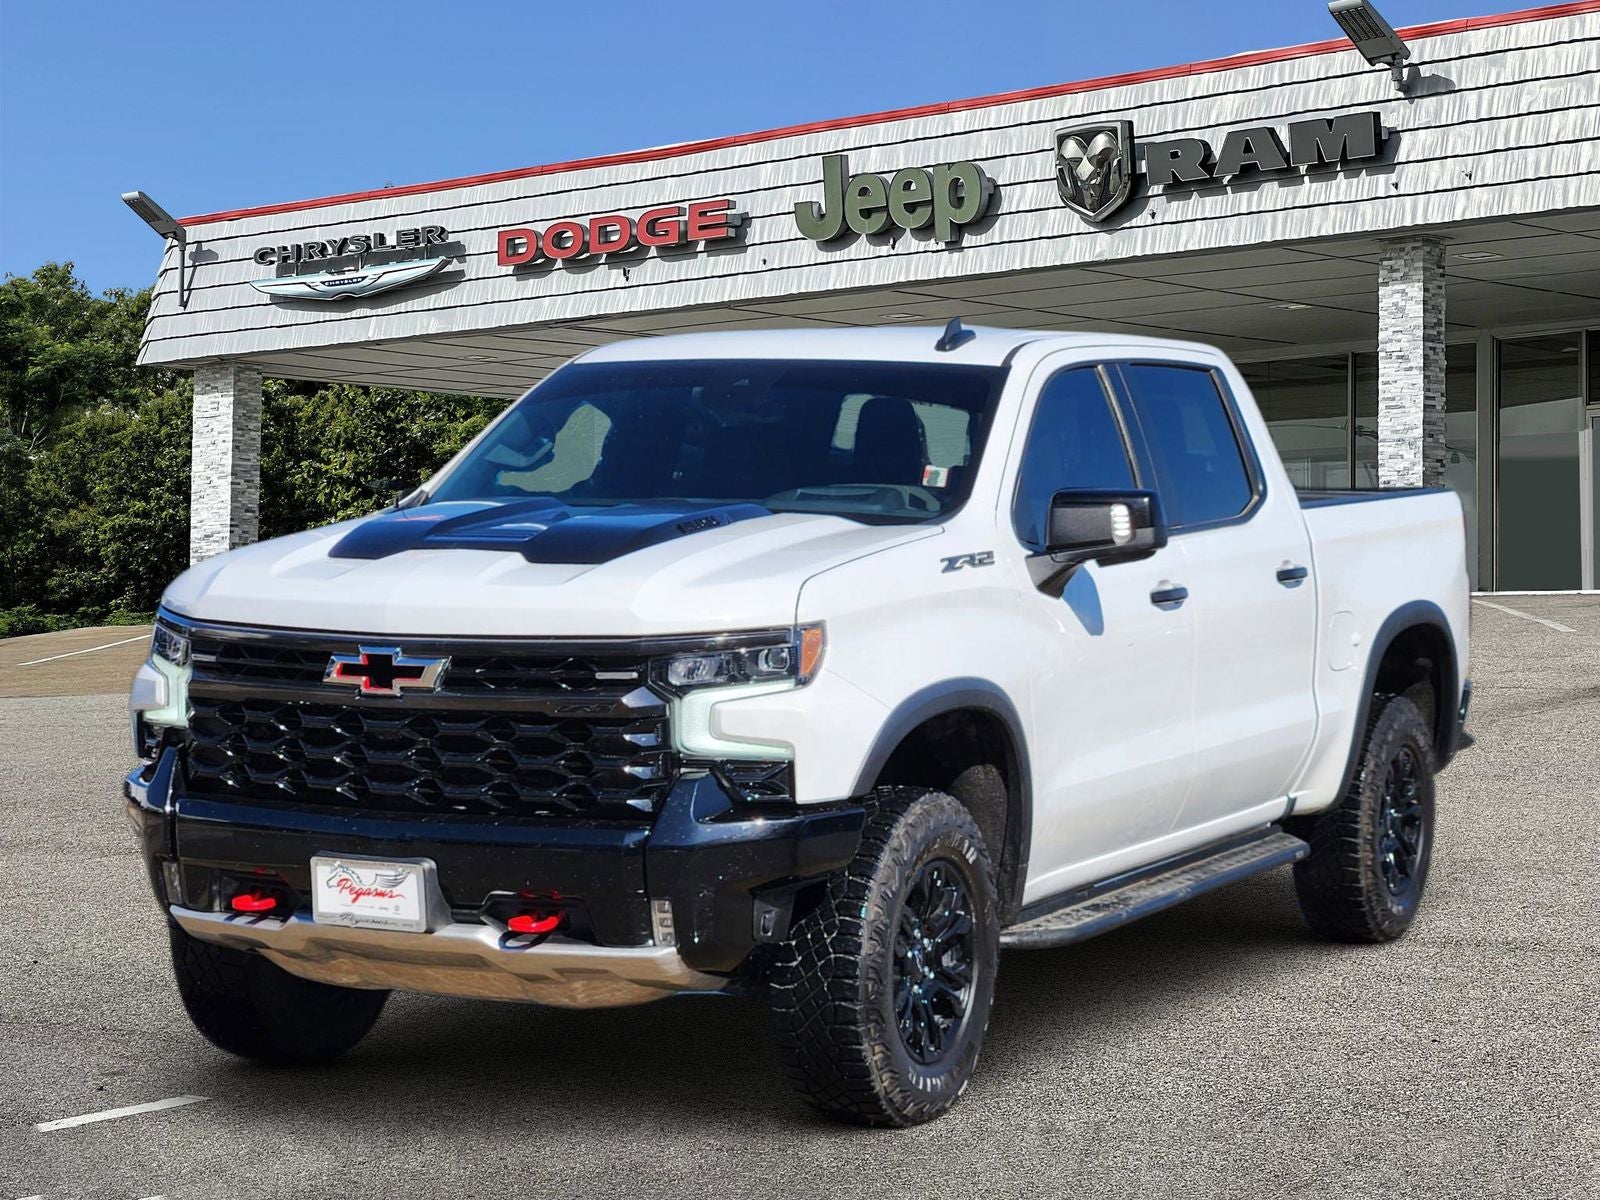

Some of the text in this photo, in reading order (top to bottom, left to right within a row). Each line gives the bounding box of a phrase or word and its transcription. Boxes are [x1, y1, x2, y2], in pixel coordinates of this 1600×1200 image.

[1145, 111, 1381, 186] RAM
[794, 154, 989, 243] Jeep
[253, 225, 448, 266] CHRYSLER
[497, 199, 736, 266] DODGE
[325, 278, 362, 286] CHRYSLER
[940, 550, 995, 574] ZR2
[337, 878, 406, 904] Pegasus
